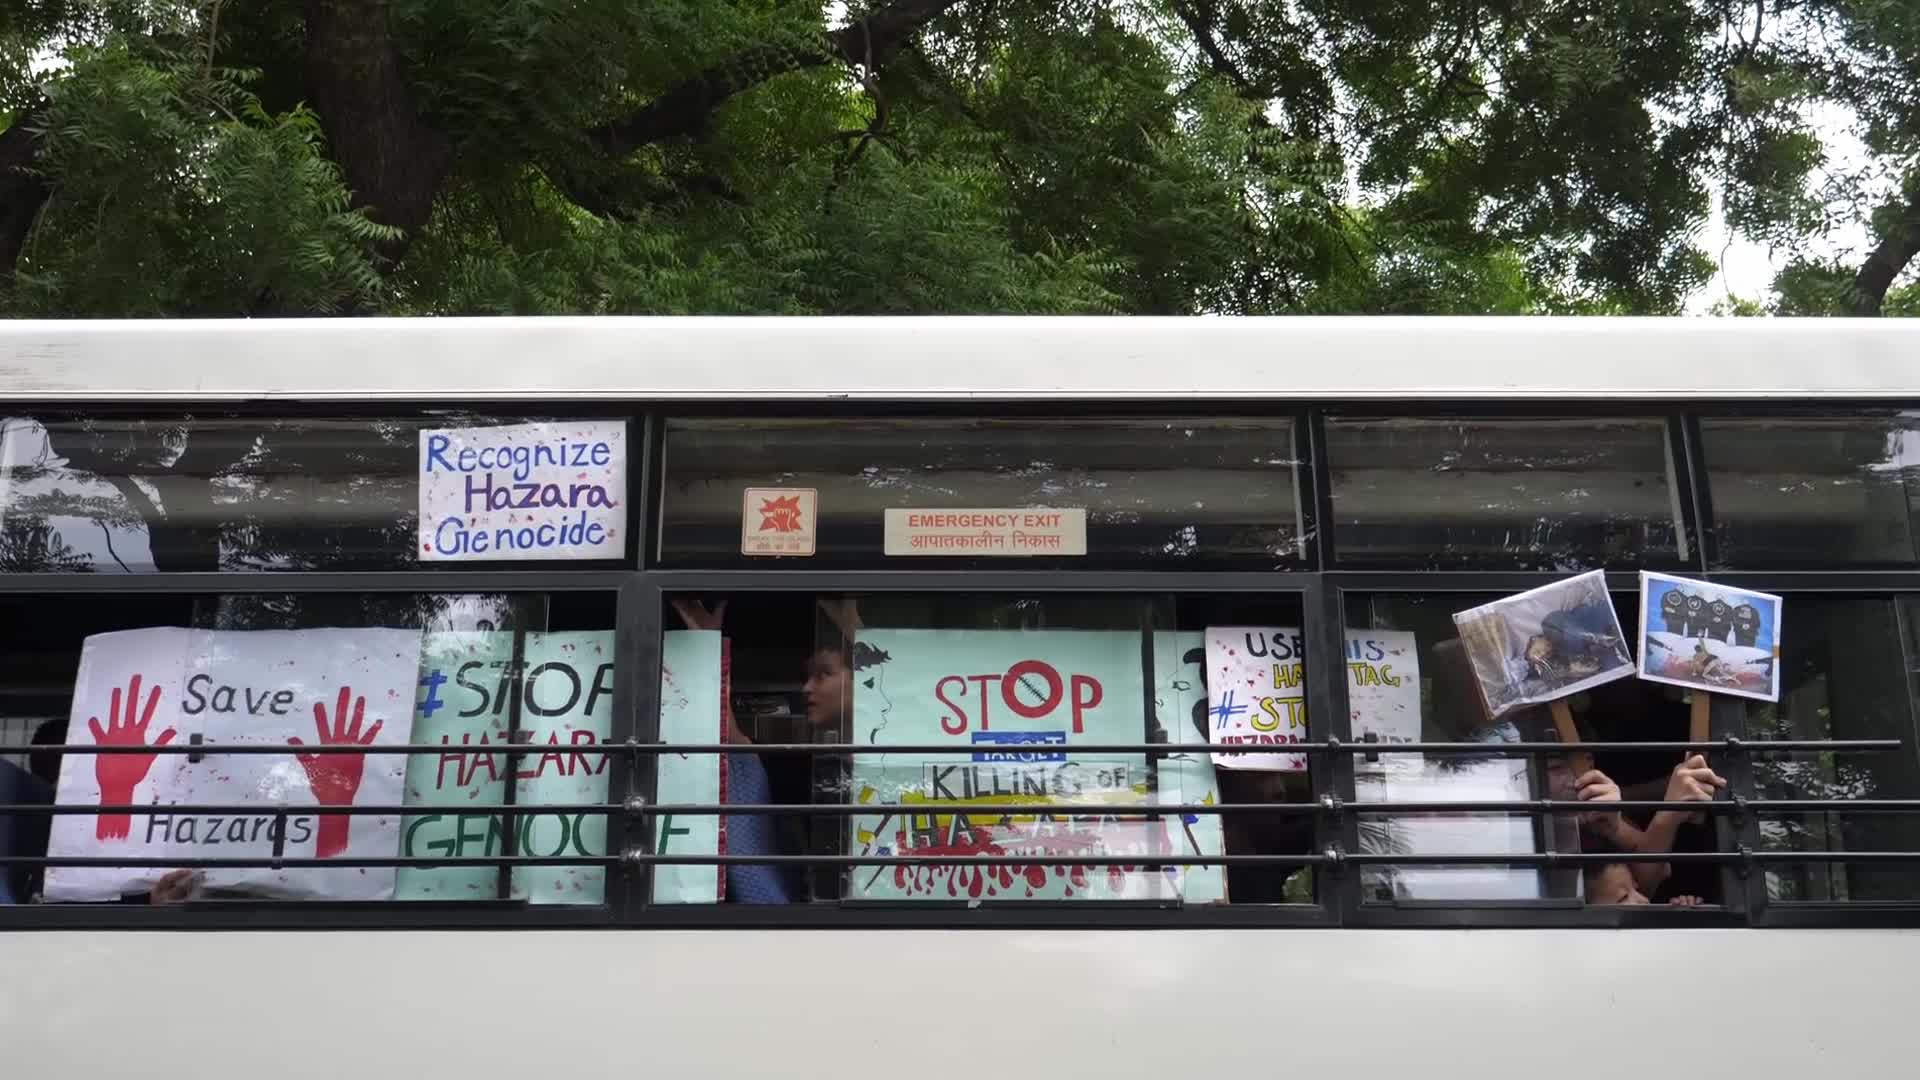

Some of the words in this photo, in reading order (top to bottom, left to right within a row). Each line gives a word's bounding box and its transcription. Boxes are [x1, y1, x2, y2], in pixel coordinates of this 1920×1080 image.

[426, 434, 610, 481] Recognize
[465, 473, 618, 513] Hazara
[435, 511, 606, 555] Genocide
[909, 514, 1018, 527] EMERGENCY
[1024, 514, 1061, 527] EXIT
[910, 530, 1004, 549] आपातकालीन
[1012, 530, 1061, 549] निकास
[182, 673, 295, 716] Save
[1273, 662, 1400, 689] HATAG
[935, 660, 1103, 735] STOP
